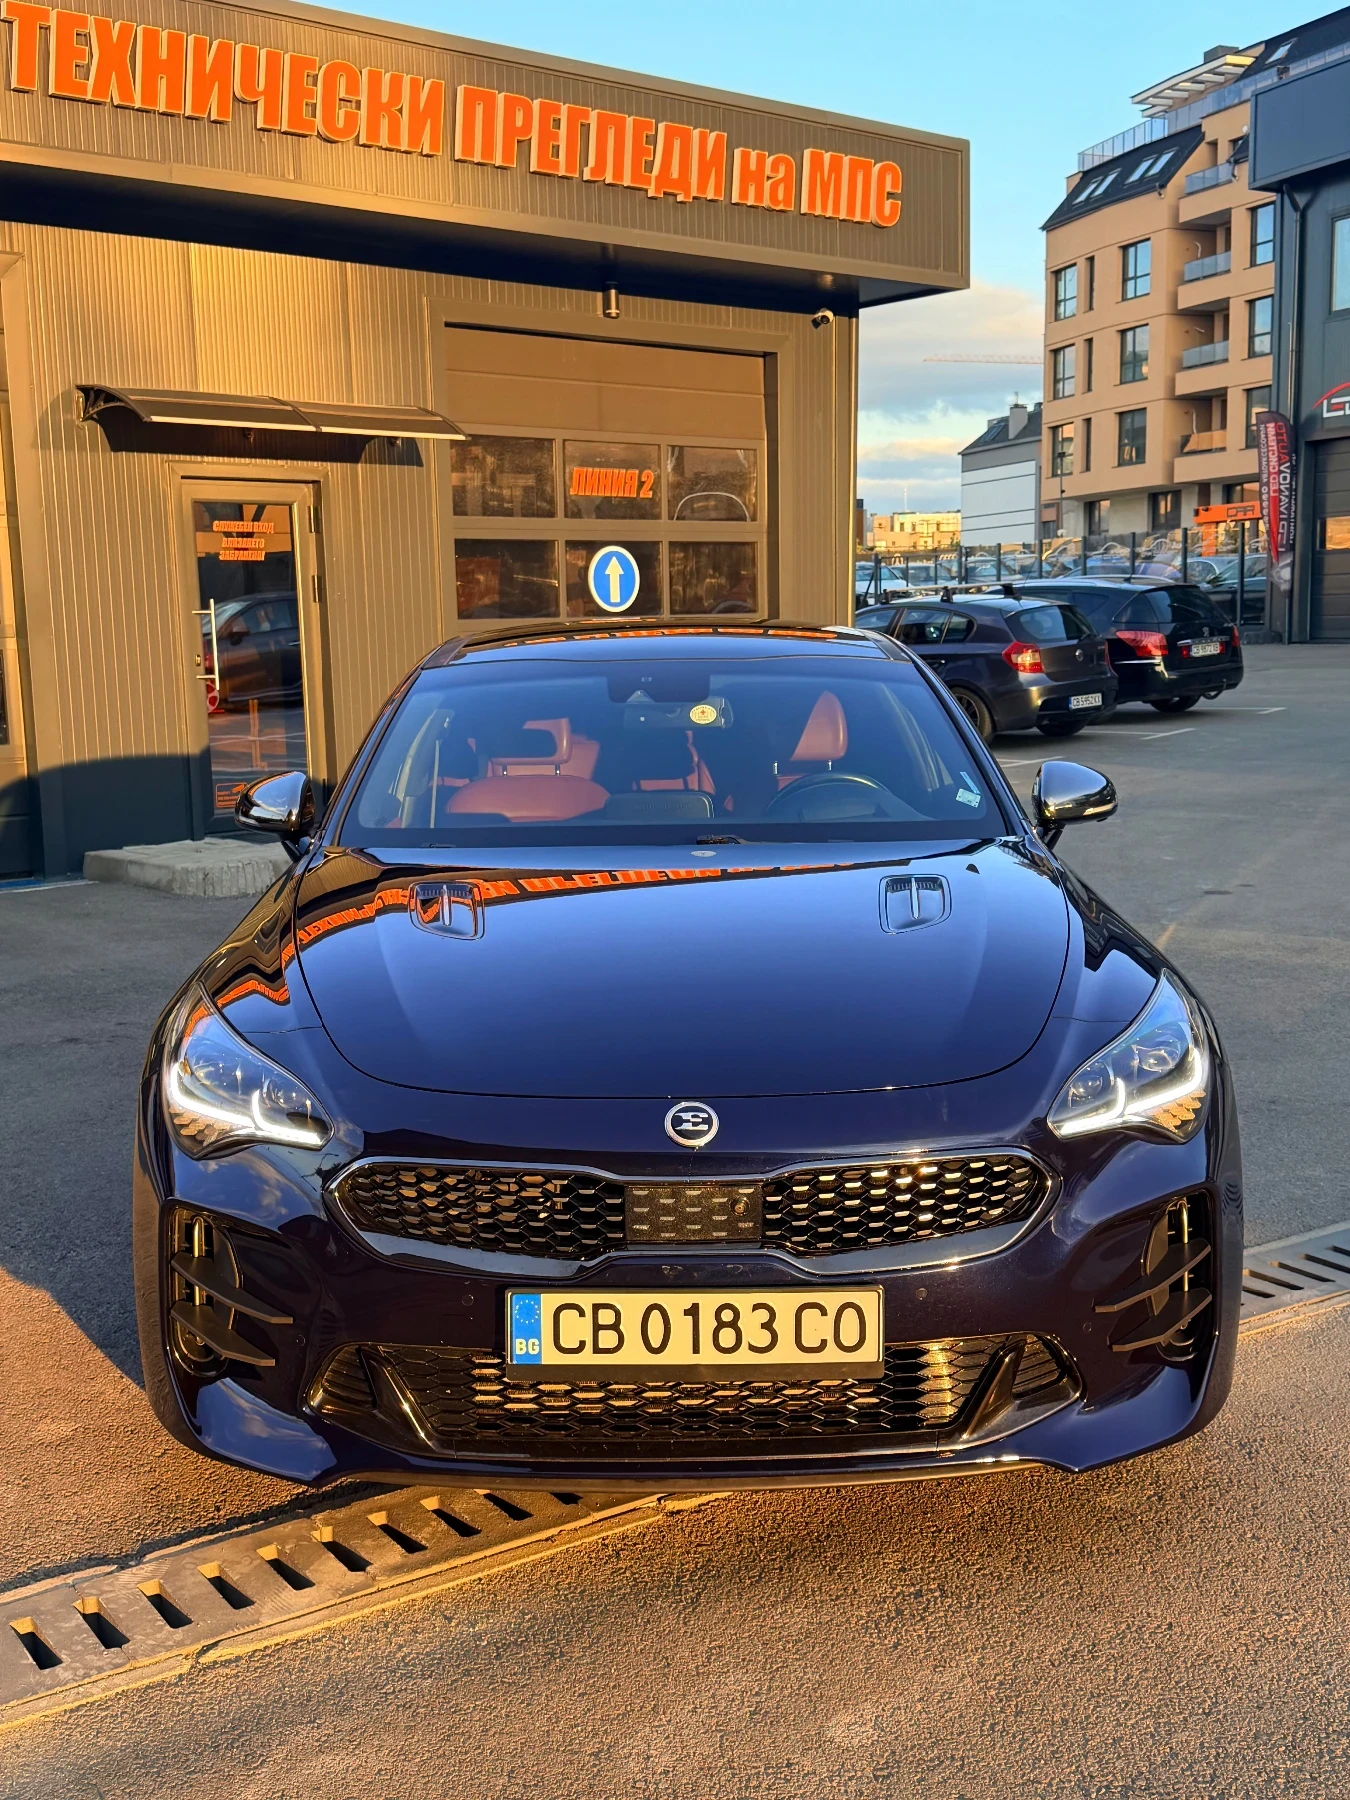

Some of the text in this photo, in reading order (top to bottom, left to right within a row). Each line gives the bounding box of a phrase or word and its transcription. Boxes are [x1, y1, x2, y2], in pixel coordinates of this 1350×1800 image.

[1, 0, 902, 228] ТЕХНИЧЕСКИ ПРЕГЛЕДИ на МПС
[569, 466, 655, 498] ЛИНИЯ 2
[515, 1338, 540, 1355] BG
[552, 1301, 867, 1355] CB 0183 CO
